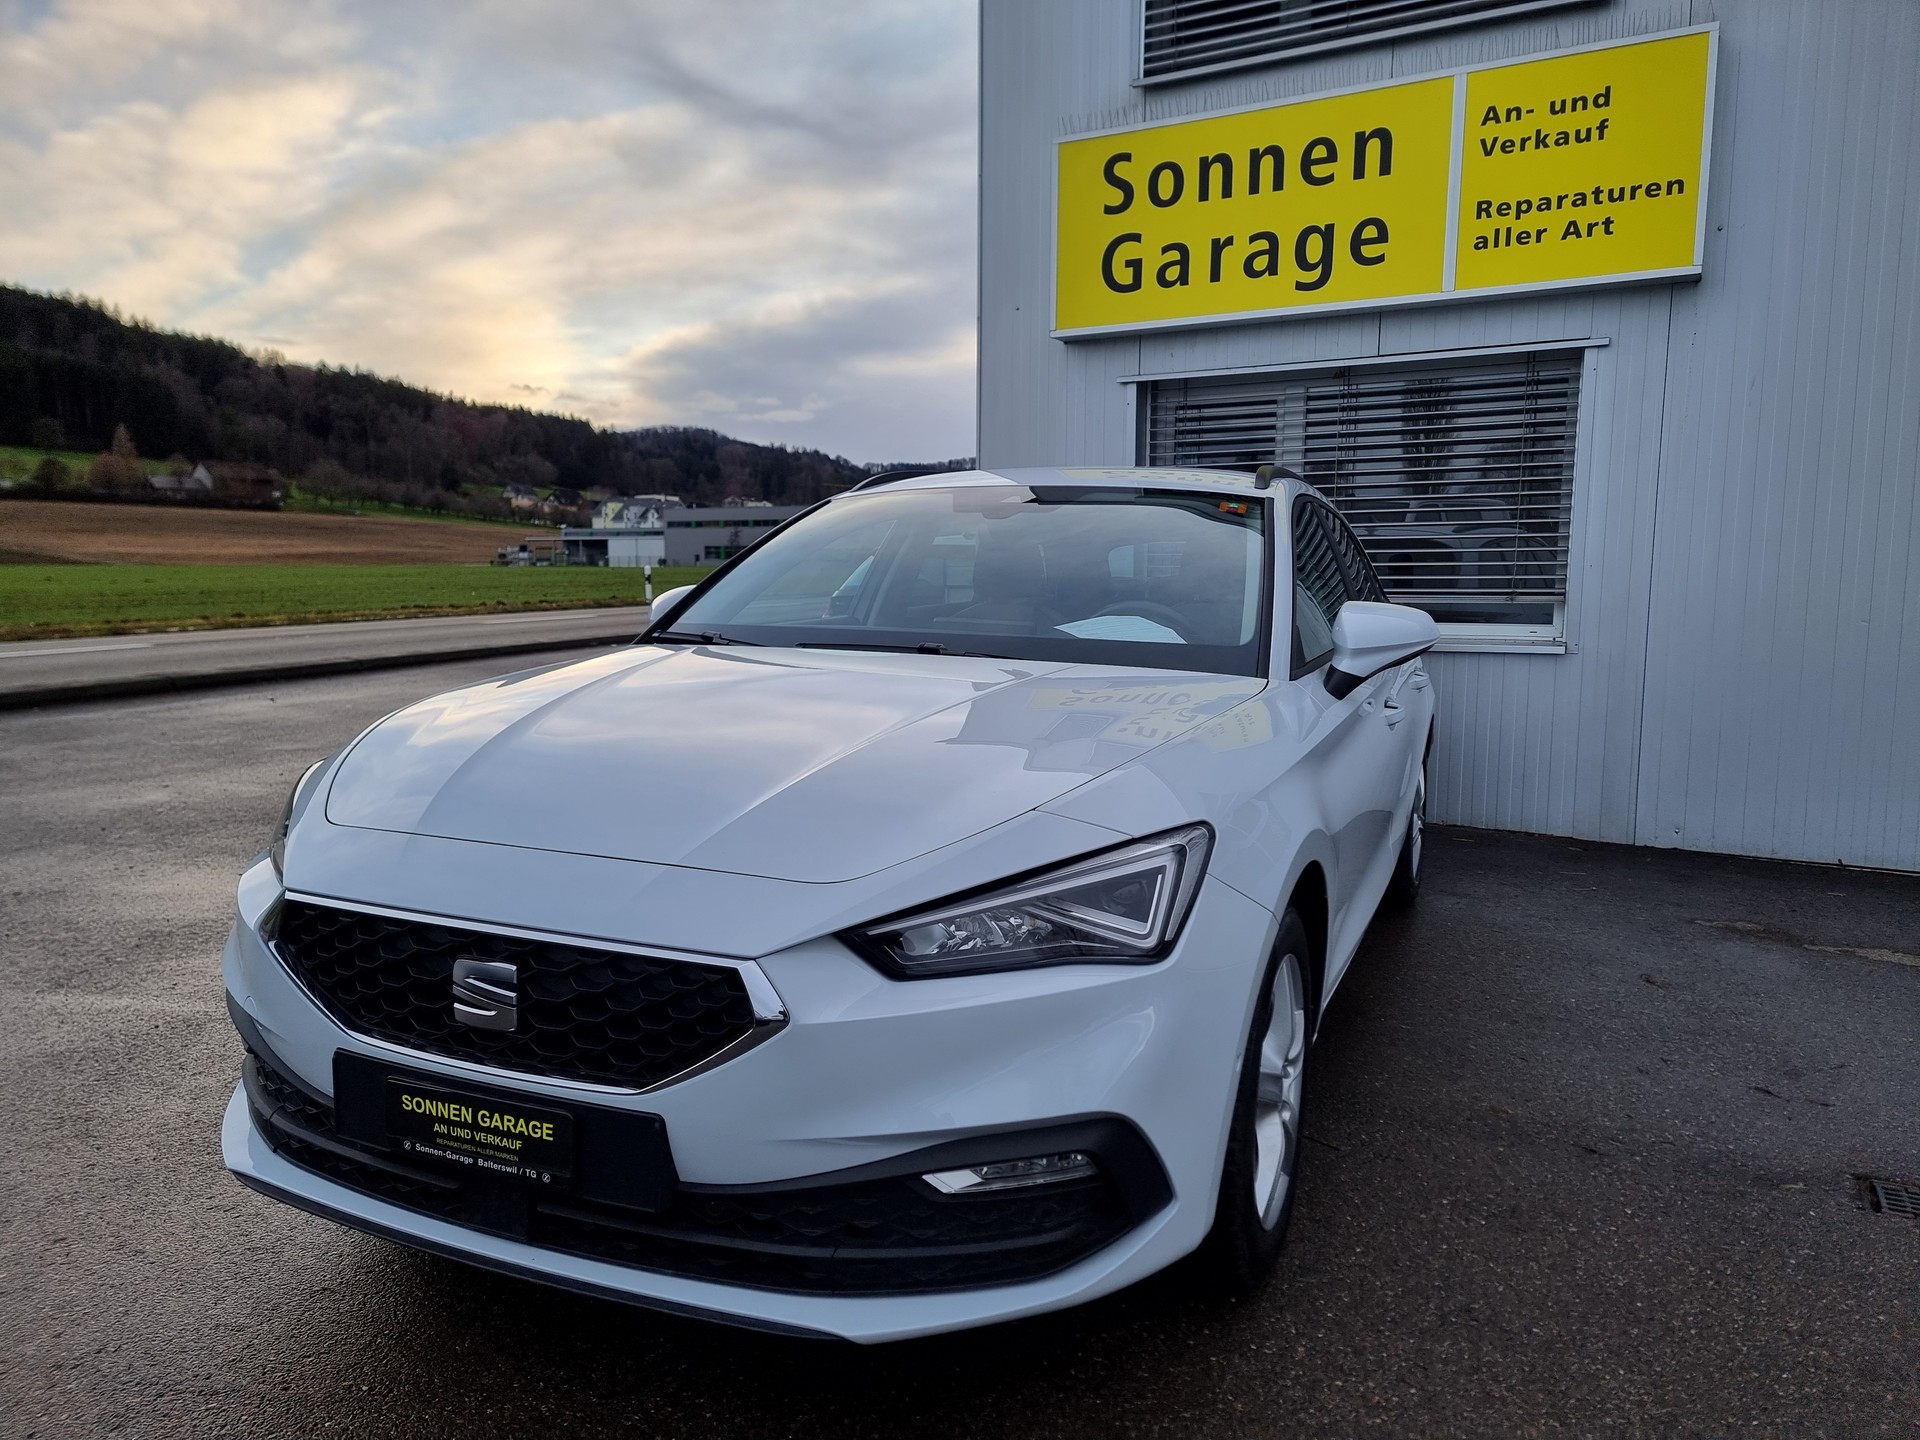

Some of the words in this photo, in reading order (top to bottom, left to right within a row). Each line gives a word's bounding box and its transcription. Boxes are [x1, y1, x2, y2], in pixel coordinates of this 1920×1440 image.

[1480, 105, 1535, 127] An-
[1549, 85, 1612, 116] und
[1479, 117, 1610, 157] Verkauf
[1103, 127, 1393, 216] Sonnen
[1475, 178, 1685, 220] Reparaturen
[1473, 226, 1548, 251] aller
[1560, 215, 1615, 241] Art
[1101, 217, 1389, 294] Garage
[402, 1094, 472, 1124] SONNEN
[478, 1110, 554, 1141] GARAGE
[433, 1123, 448, 1135] AN
[450, 1126, 472, 1139] UND
[473, 1131, 523, 1151] VERKAUF
[415, 1143, 474, 1164] Sonnen-Garage
[477, 1158, 518, 1174] Balterswil
[525, 1168, 537, 1179] TG
[436, 1137, 476, 1152] REPARATUREN
[476, 1146, 495, 1157] ALLER
[494, 1150, 519, 1162] MARKEN
